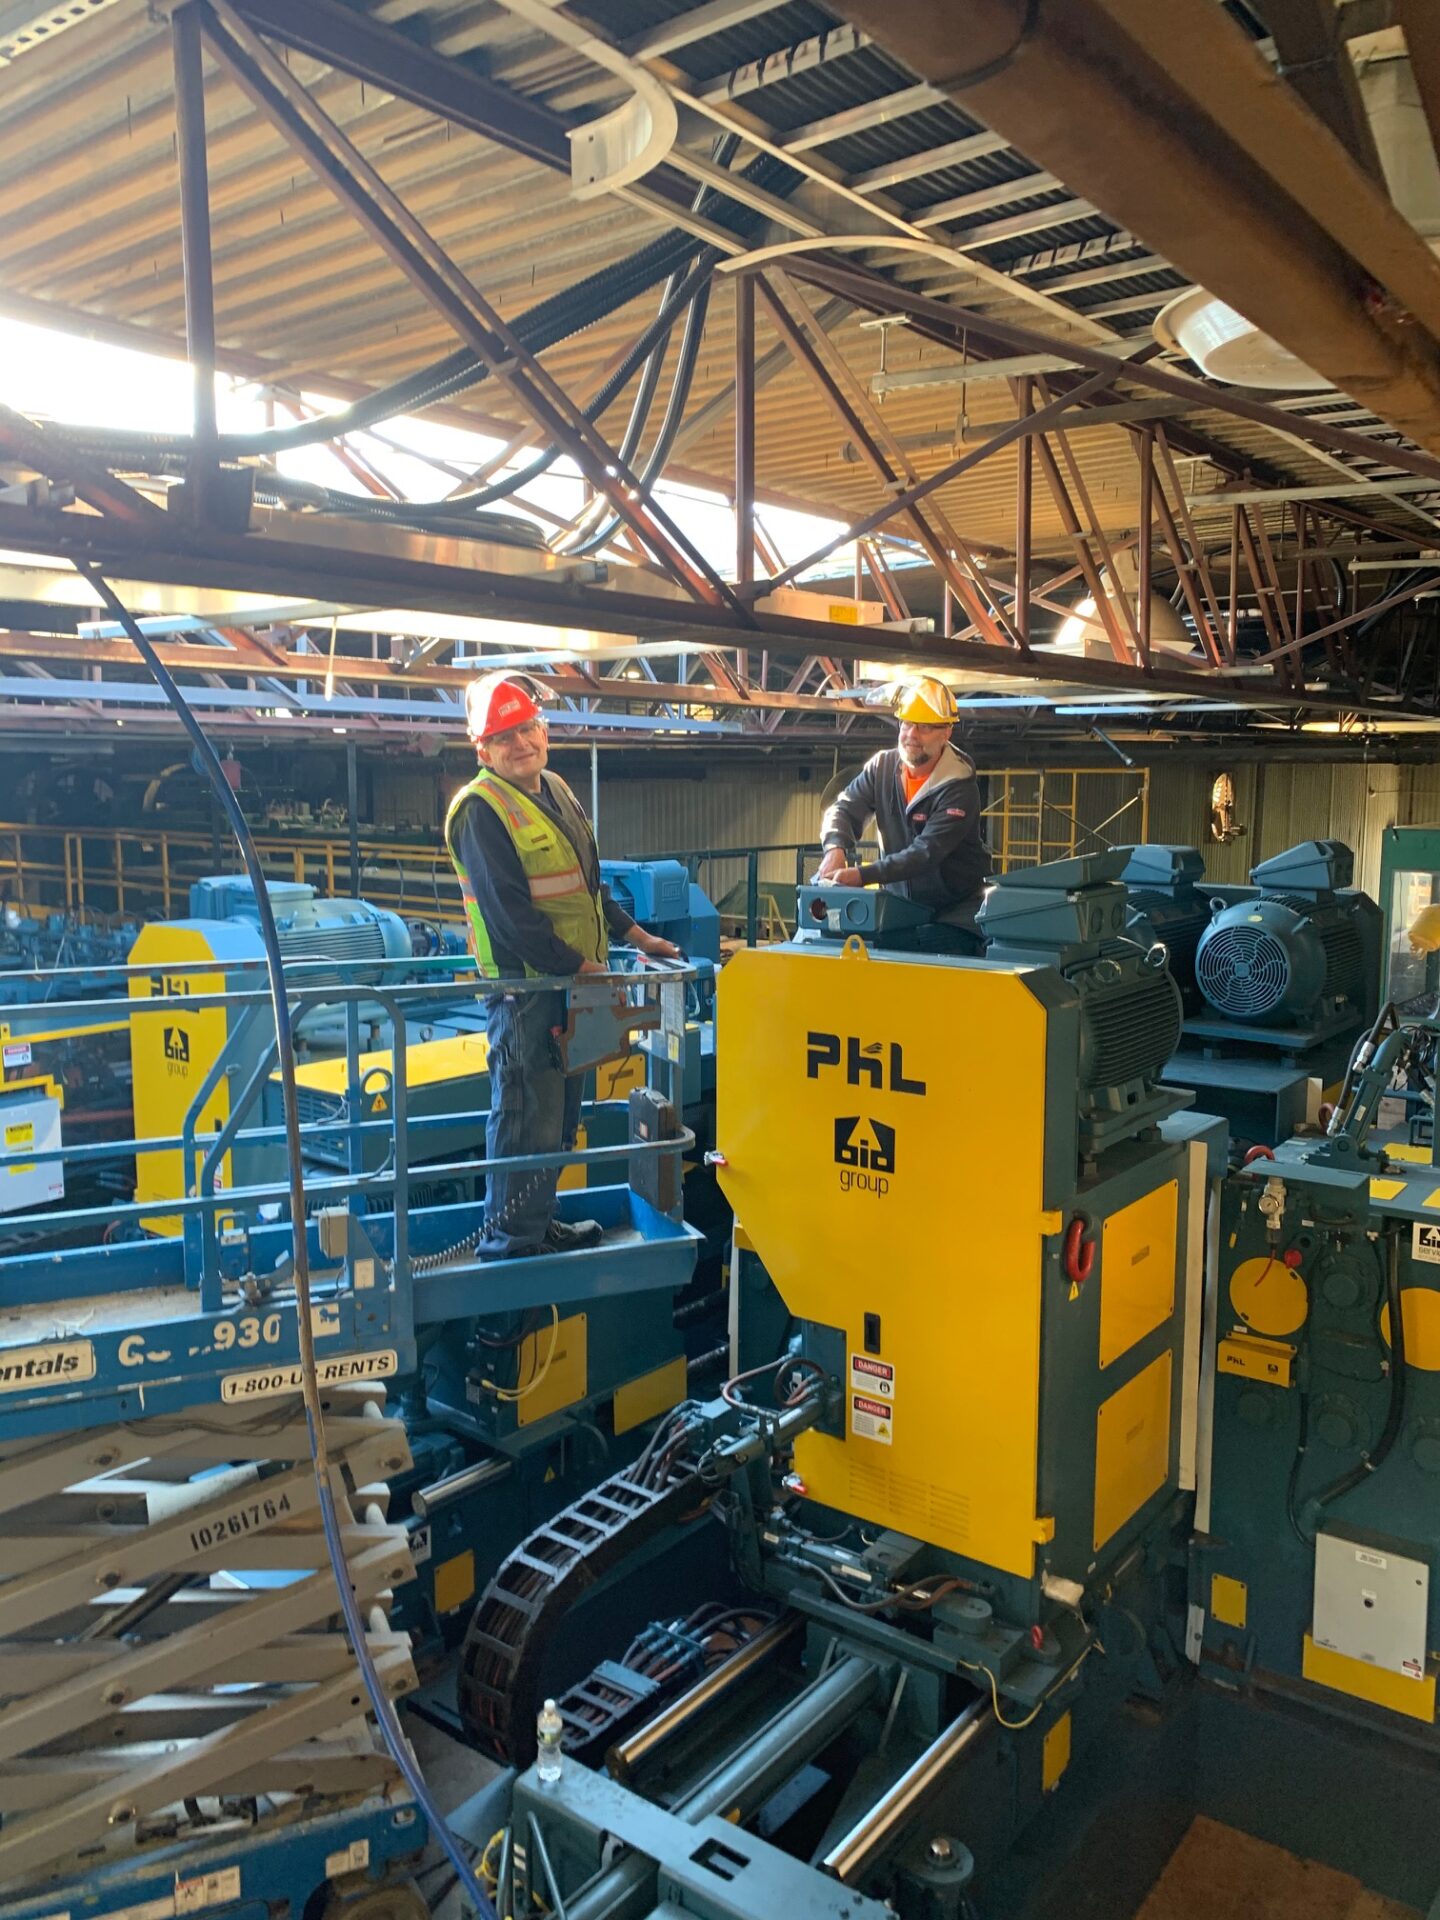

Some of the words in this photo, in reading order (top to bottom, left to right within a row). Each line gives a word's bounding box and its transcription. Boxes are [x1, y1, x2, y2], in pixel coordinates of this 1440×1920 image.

[167, 1061, 189, 1079] group
[839, 1169, 889, 1199] group
[229, 1356, 390, 1396] 1-800-U-RENTS
[857, 1359, 888, 1377] DANGER
[857, 1400, 887, 1416] DANGER
[190, 1493, 291, 1551] 10261764
